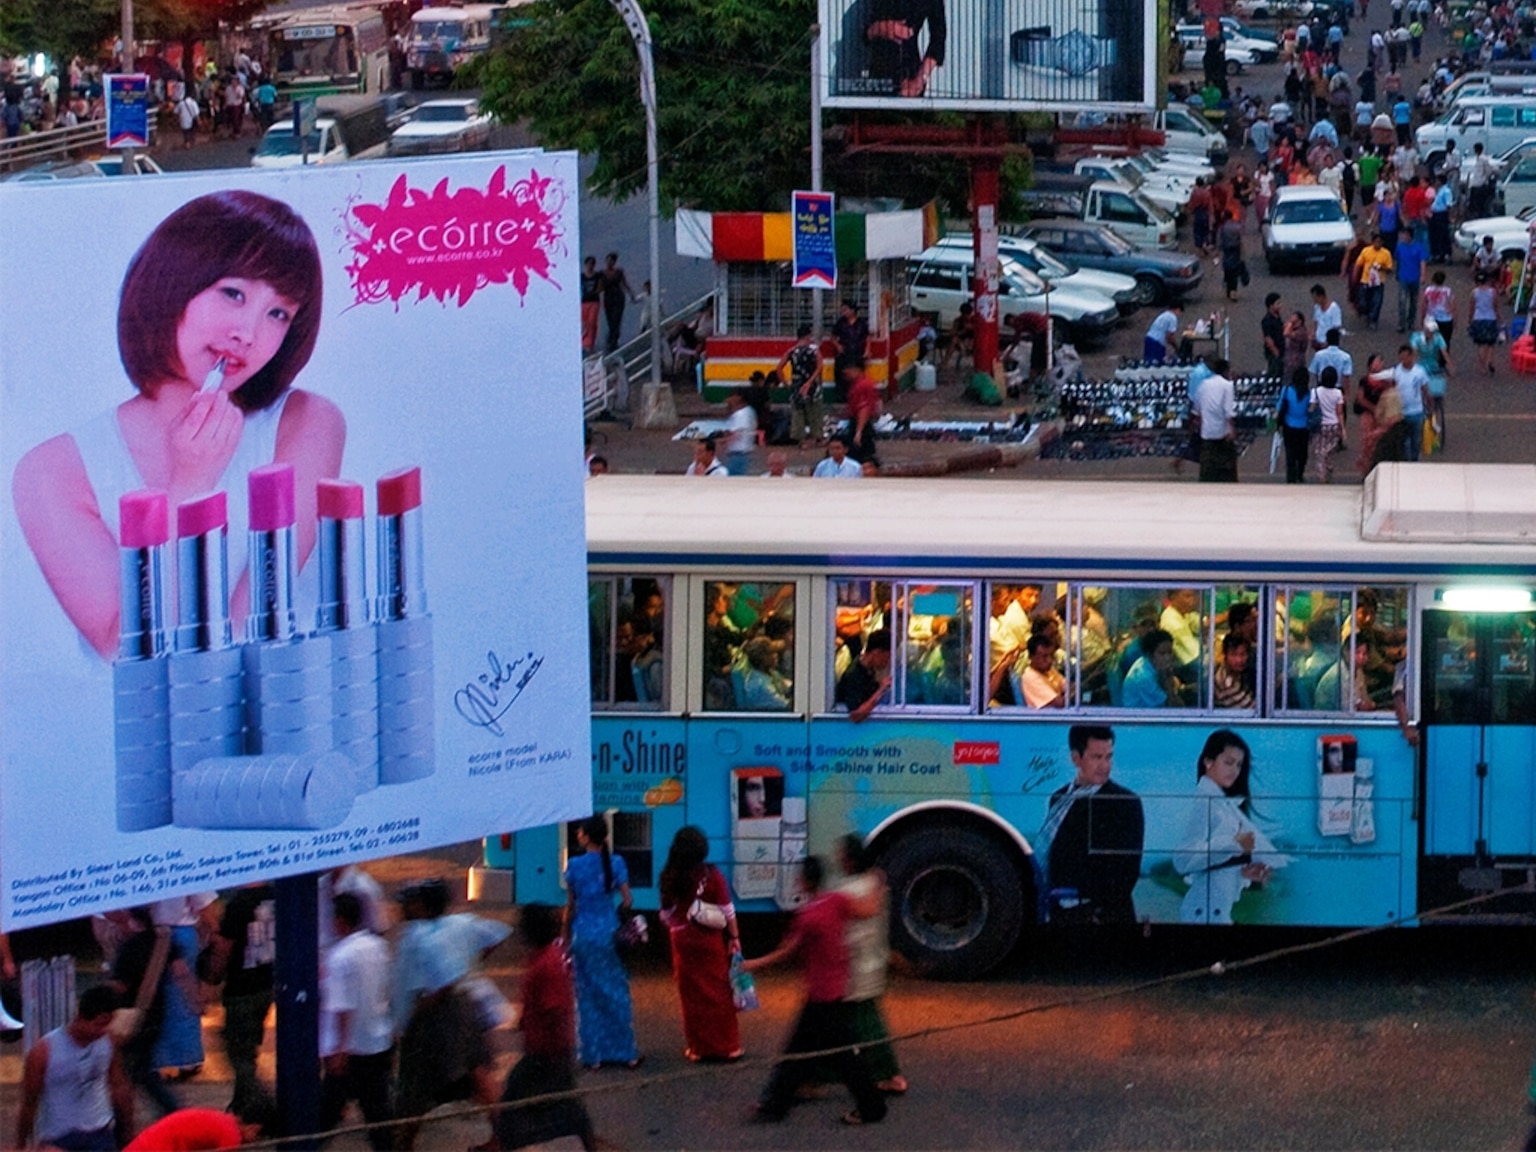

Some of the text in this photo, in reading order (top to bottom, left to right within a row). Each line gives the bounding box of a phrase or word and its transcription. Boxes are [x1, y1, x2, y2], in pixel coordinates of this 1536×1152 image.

[407, 248, 503, 265] www.ecorre.co.kr
[592, 730, 685, 774] -n-Shine
[754, 743, 901, 756] Soft and Smooth with
[877, 762, 905, 774] Hair
[909, 762, 941, 774] Coat
